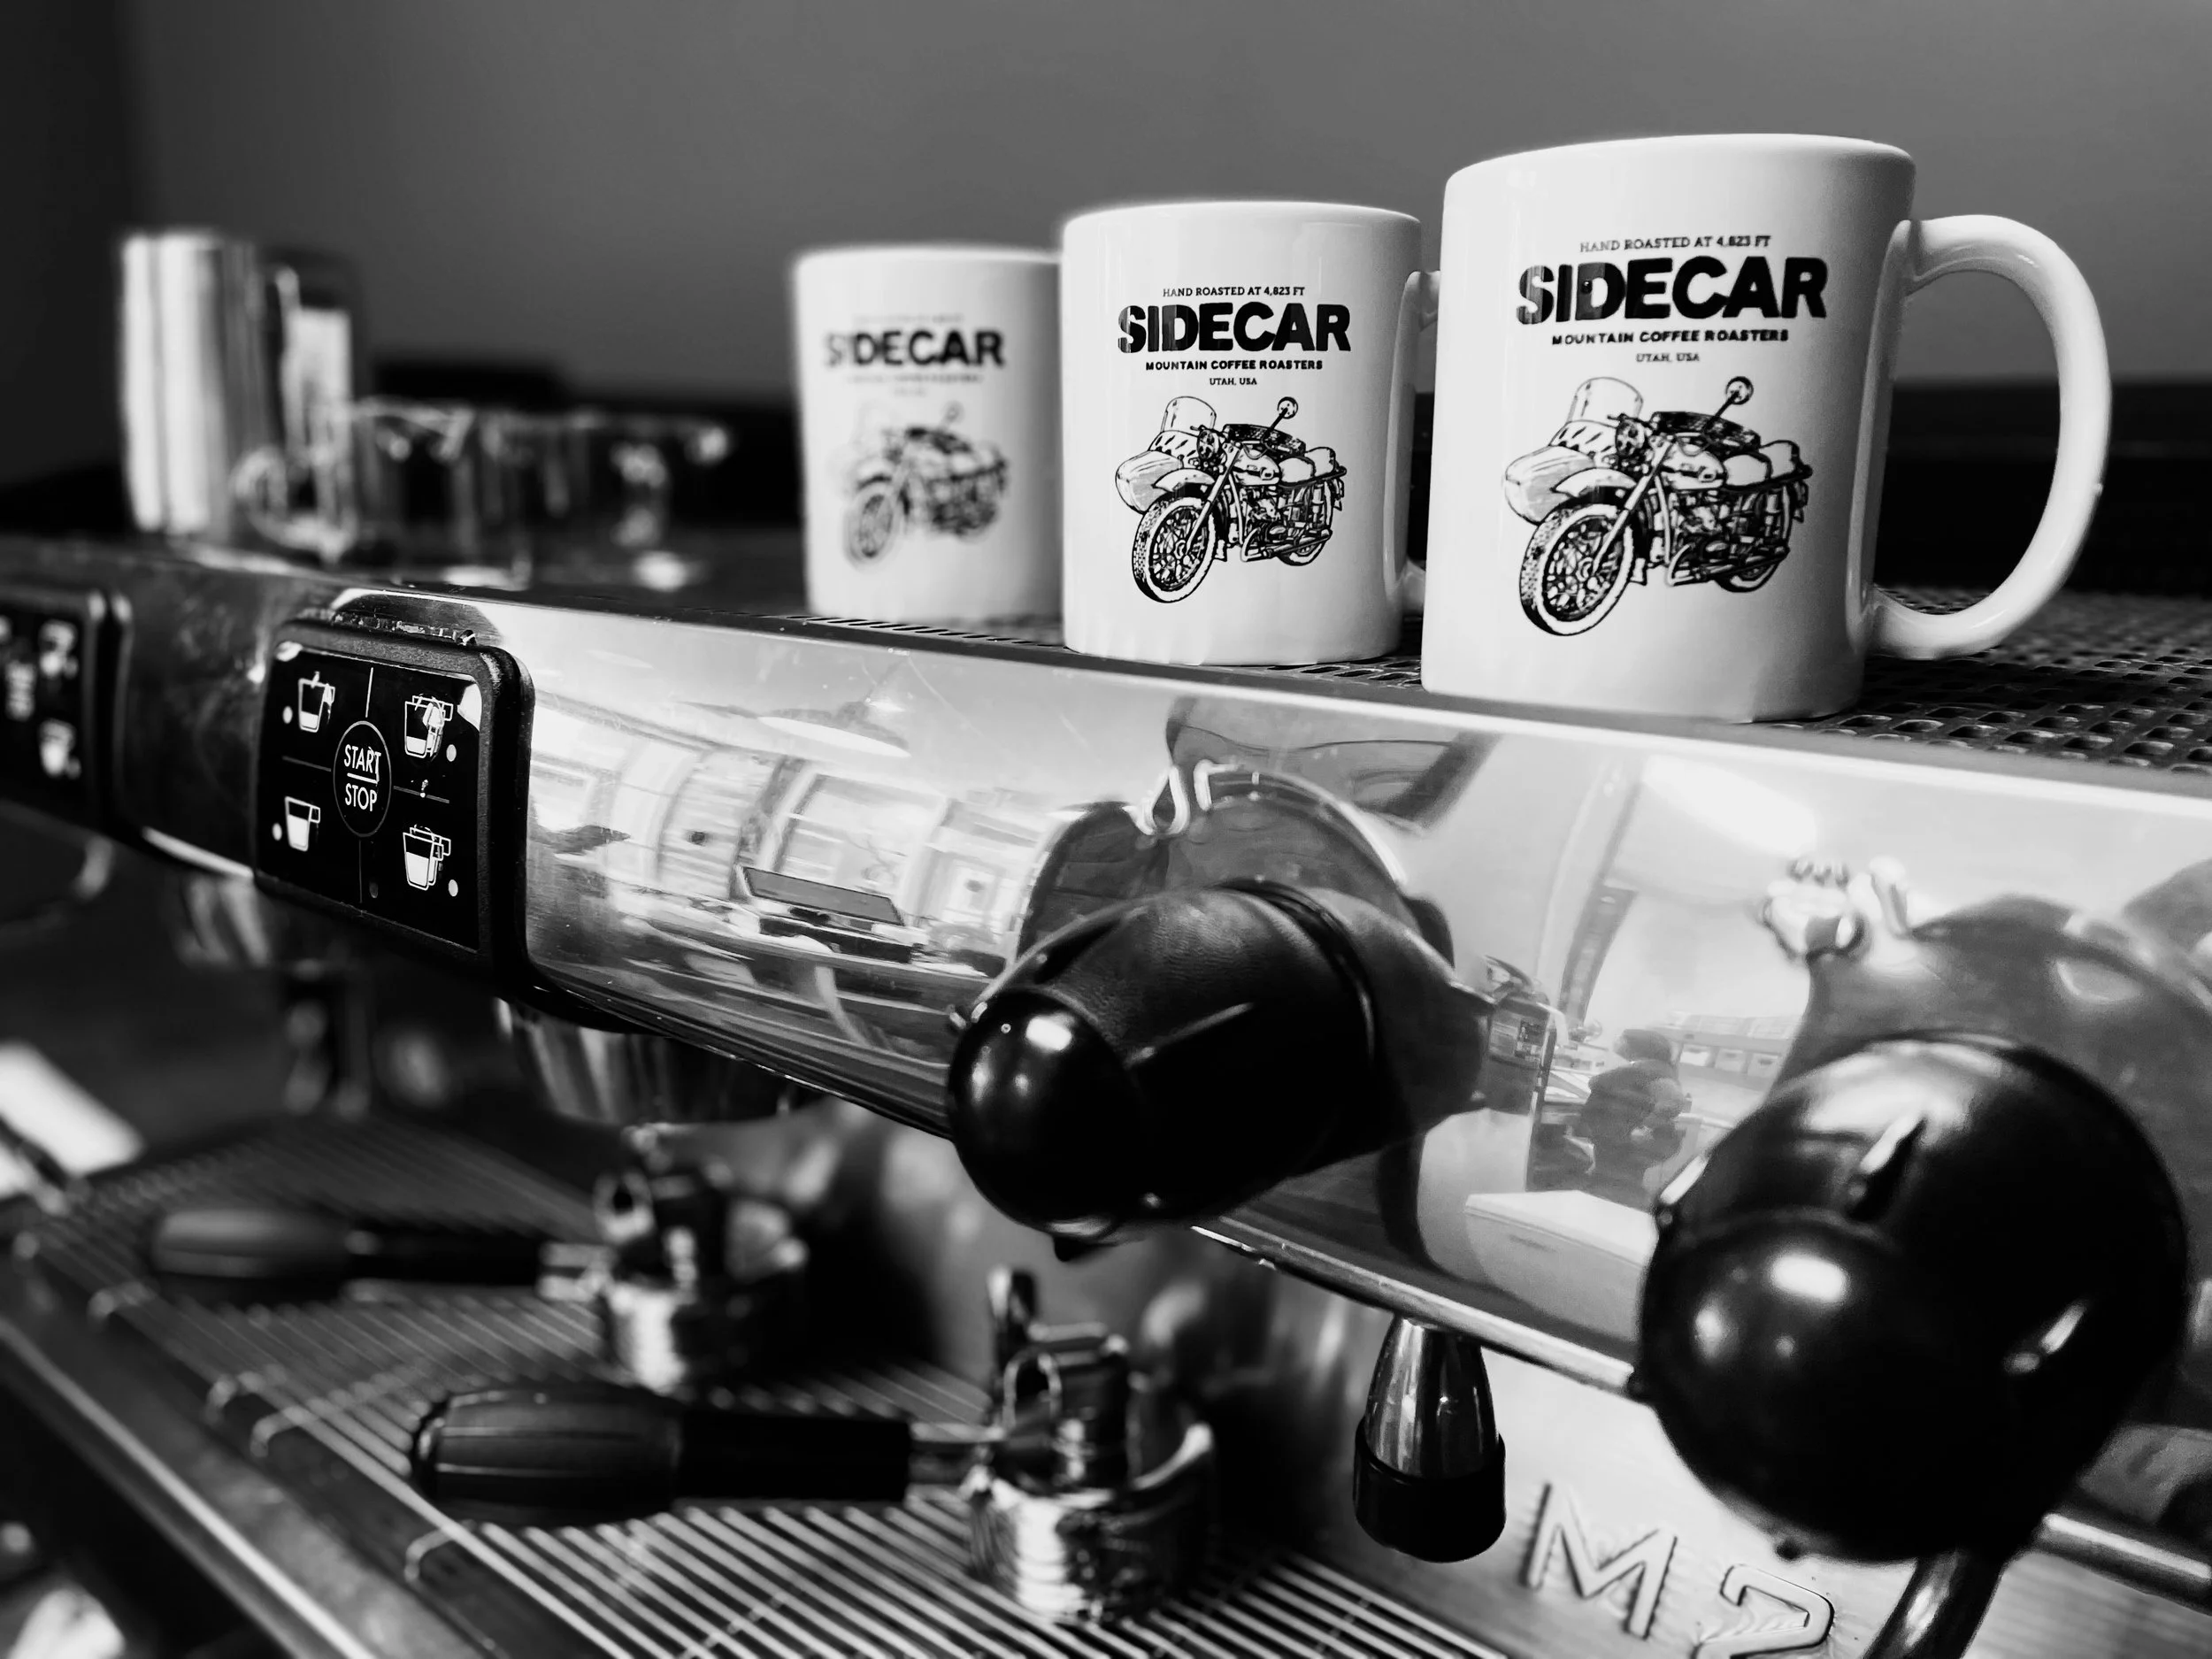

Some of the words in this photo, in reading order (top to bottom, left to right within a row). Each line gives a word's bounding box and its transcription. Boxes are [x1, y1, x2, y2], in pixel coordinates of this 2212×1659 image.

[1580, 240, 1620, 253] HAND
[1624, 236, 1690, 250] ROASTED
[1694, 235, 1711, 247] AT
[1755, 234, 1771, 247] FT
[1163, 288, 1193, 297] HAND
[1195, 286, 1245, 296] ROASTED
[1248, 286, 1262, 296] AT
[1263, 286, 1290, 296] 4,823
[1293, 286, 1305, 296] FT
[1516, 256, 1828, 325] SIDECAR
[1118, 301, 1351, 354] SIDECAR
[1552, 332, 1634, 345] MOUNTAIN
[1640, 329, 1700, 342] COFFEE
[1704, 329, 1789, 342] ROASTERS
[1146, 361, 1208, 371] MOUNTAIN
[1210, 359, 1256, 370] COFFEE
[1259, 359, 1324, 370] ROASTERS
[1676, 353, 1700, 362] USA
[1210, 377, 1237, 386] UTAH,
[1239, 377, 1257, 386] USA
[344, 743, 381, 774] START
[344, 782, 378, 811] STOP
